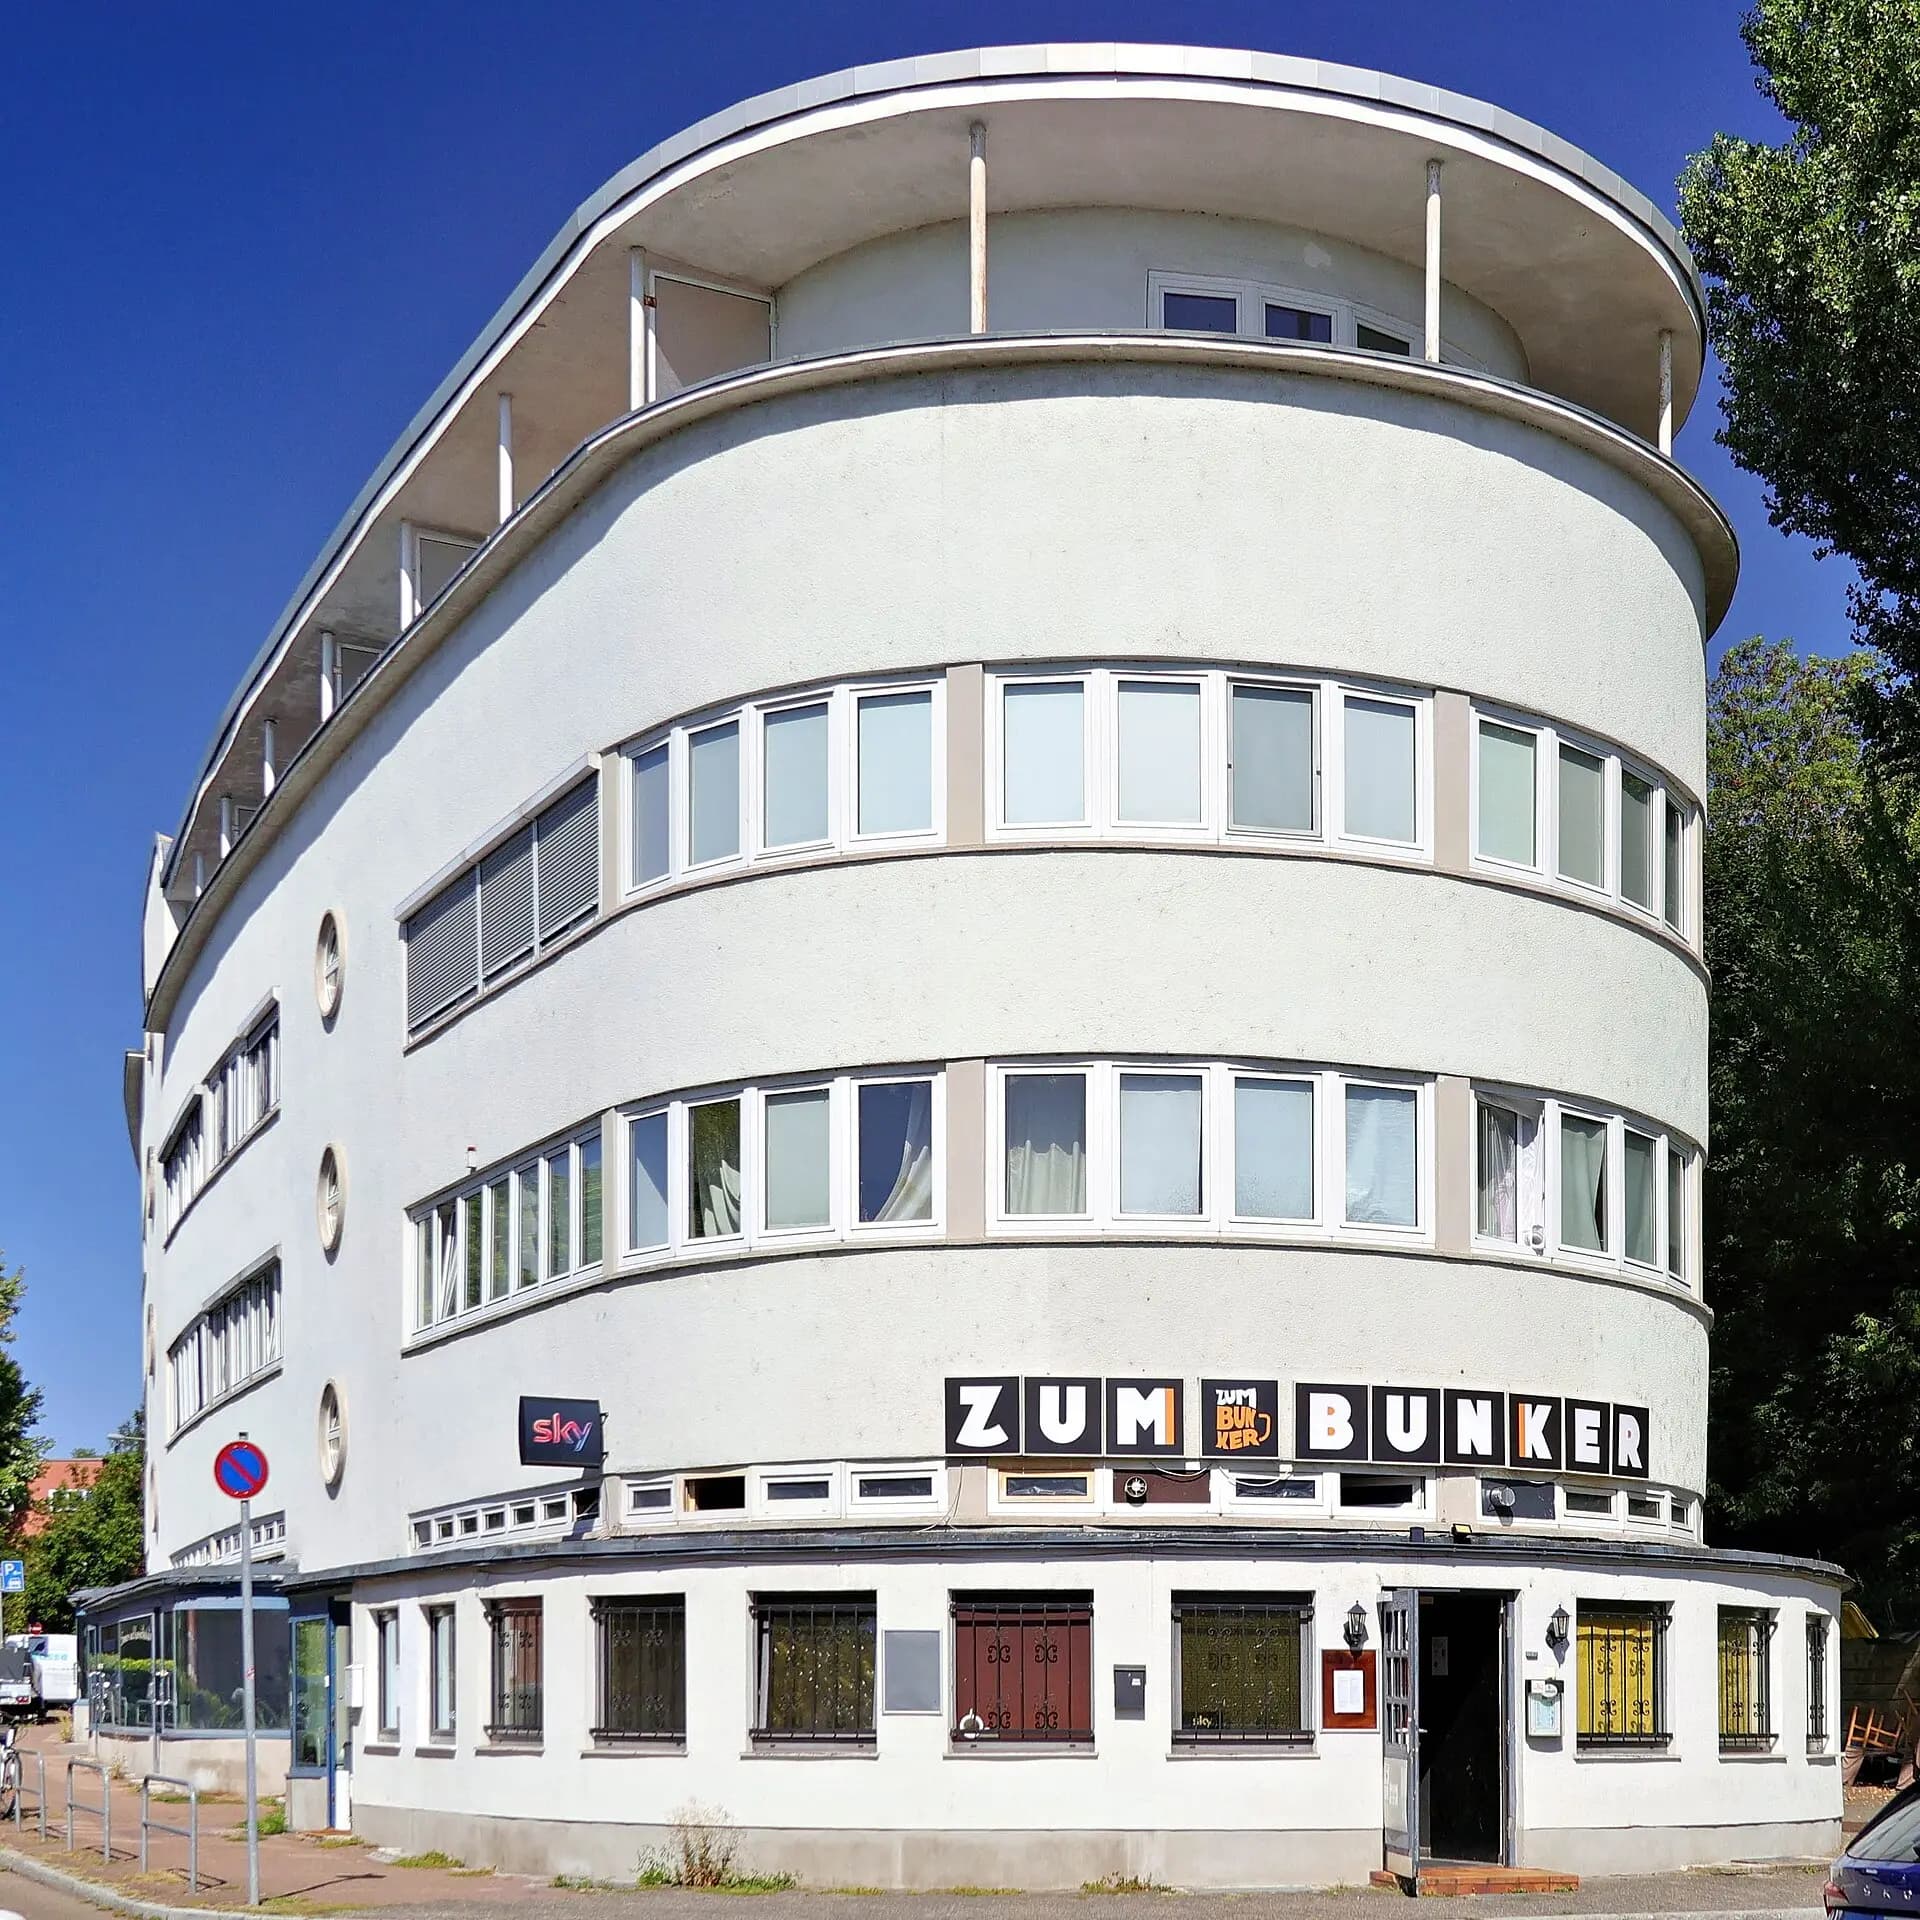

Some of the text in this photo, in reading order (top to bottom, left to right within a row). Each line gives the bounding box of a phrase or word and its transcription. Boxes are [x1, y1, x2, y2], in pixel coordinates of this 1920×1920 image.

[1215, 1387, 1257, 1409] ZUM
[955, 1385, 1643, 1469] ZUM BUNKER
[1216, 1406, 1257, 1430] BUN
[532, 1412, 593, 1452] sky
[1215, 1428, 1260, 1450] KER
[4, 1563, 15, 1576] P
